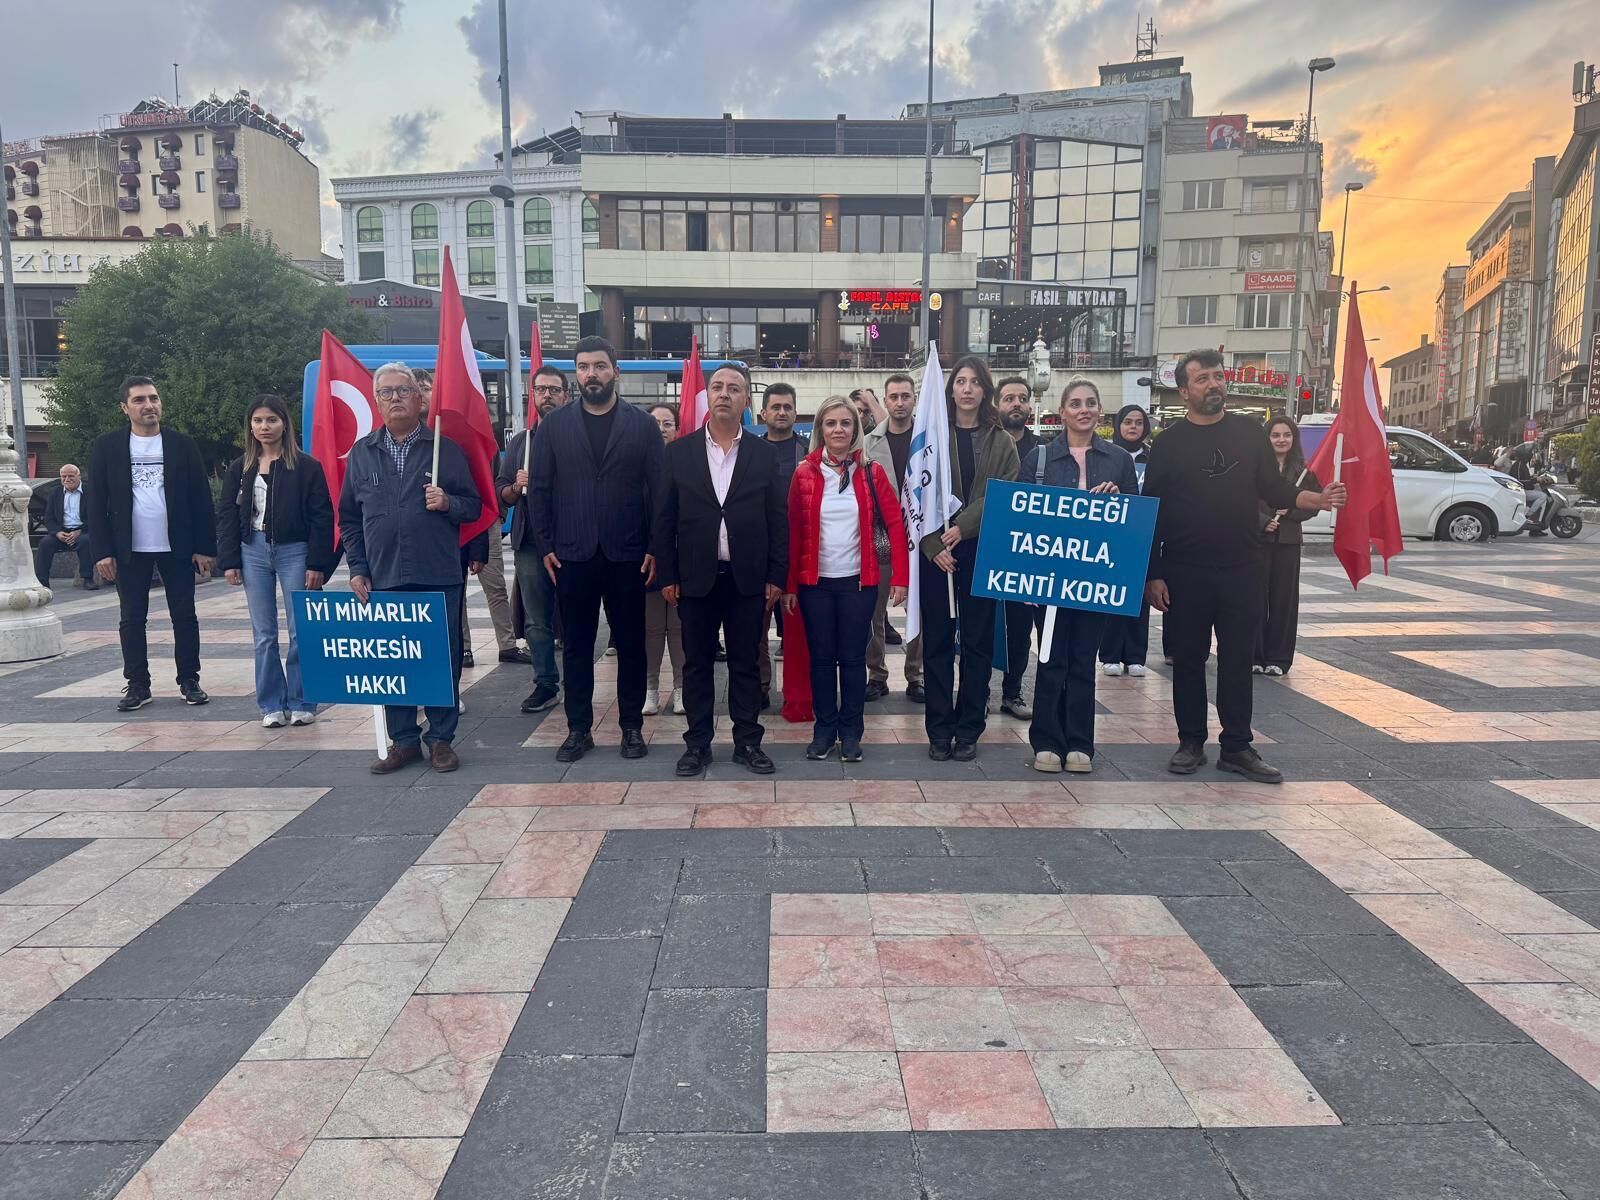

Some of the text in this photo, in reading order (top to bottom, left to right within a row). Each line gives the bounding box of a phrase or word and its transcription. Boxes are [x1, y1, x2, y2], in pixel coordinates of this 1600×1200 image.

[378, 294, 388, 307] &
[393, 294, 433, 308] Bistro
[871, 302, 909, 310] CAFE
[885, 291, 923, 303] BISTR
[978, 292, 1001, 301] CAFE
[1030, 289, 1116, 307] FASIL MEYDAN
[1011, 490, 1130, 525] GELECEĞİ
[1009, 531, 1115, 569] TASARLA,
[987, 569, 1127, 607] KENTİ KORU
[305, 597, 433, 623] İYİ MİMARLIK
[322, 635, 422, 660] HERKESİN
[345, 675, 407, 695] HAKKI
